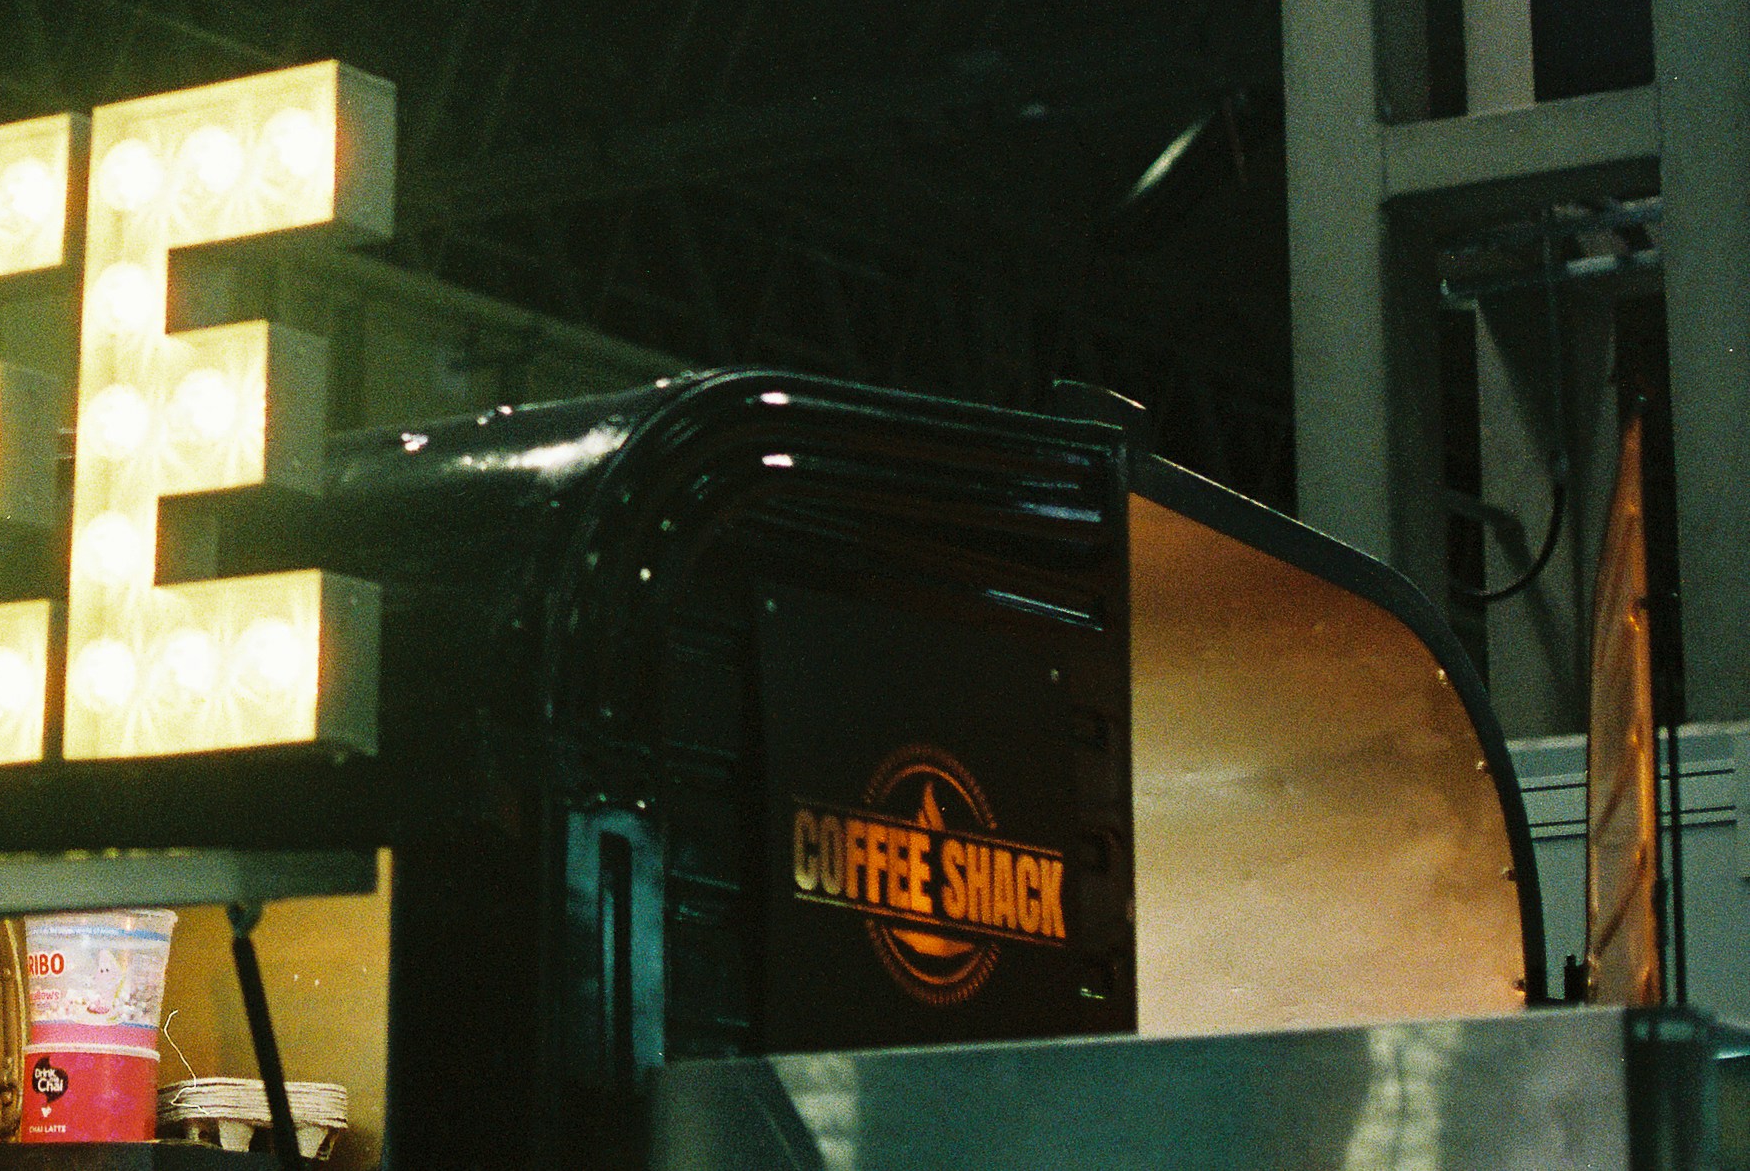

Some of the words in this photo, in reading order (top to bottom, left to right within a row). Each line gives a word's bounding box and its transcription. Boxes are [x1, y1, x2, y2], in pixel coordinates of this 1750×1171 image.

[793, 807, 934, 915] COFFEE
[941, 837, 1067, 939] SHACK
[27, 952, 65, 976] RIBO
